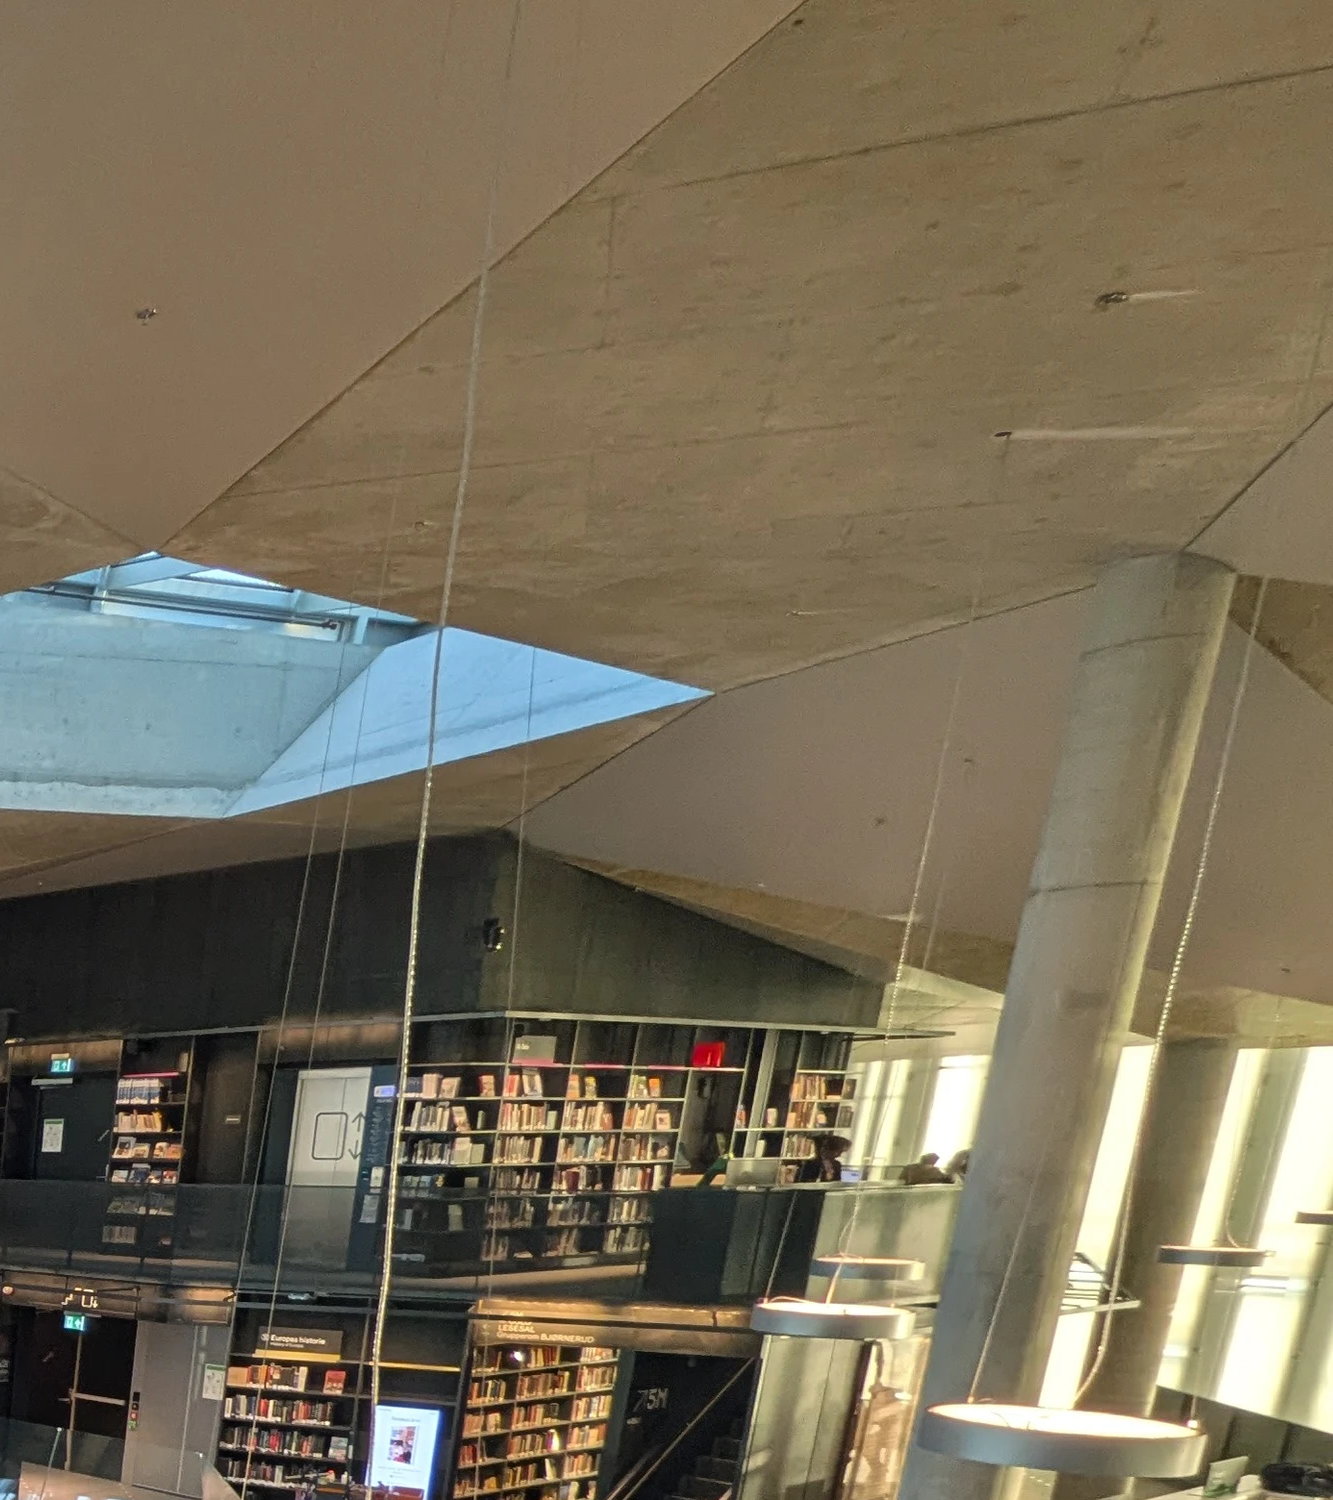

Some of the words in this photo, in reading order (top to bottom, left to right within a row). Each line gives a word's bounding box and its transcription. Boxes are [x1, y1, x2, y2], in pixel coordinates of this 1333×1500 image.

[498, 1324, 536, 1334] LESESAL
[270, 1333, 298, 1344] Europas
[299, 1335, 326, 1345] historie
